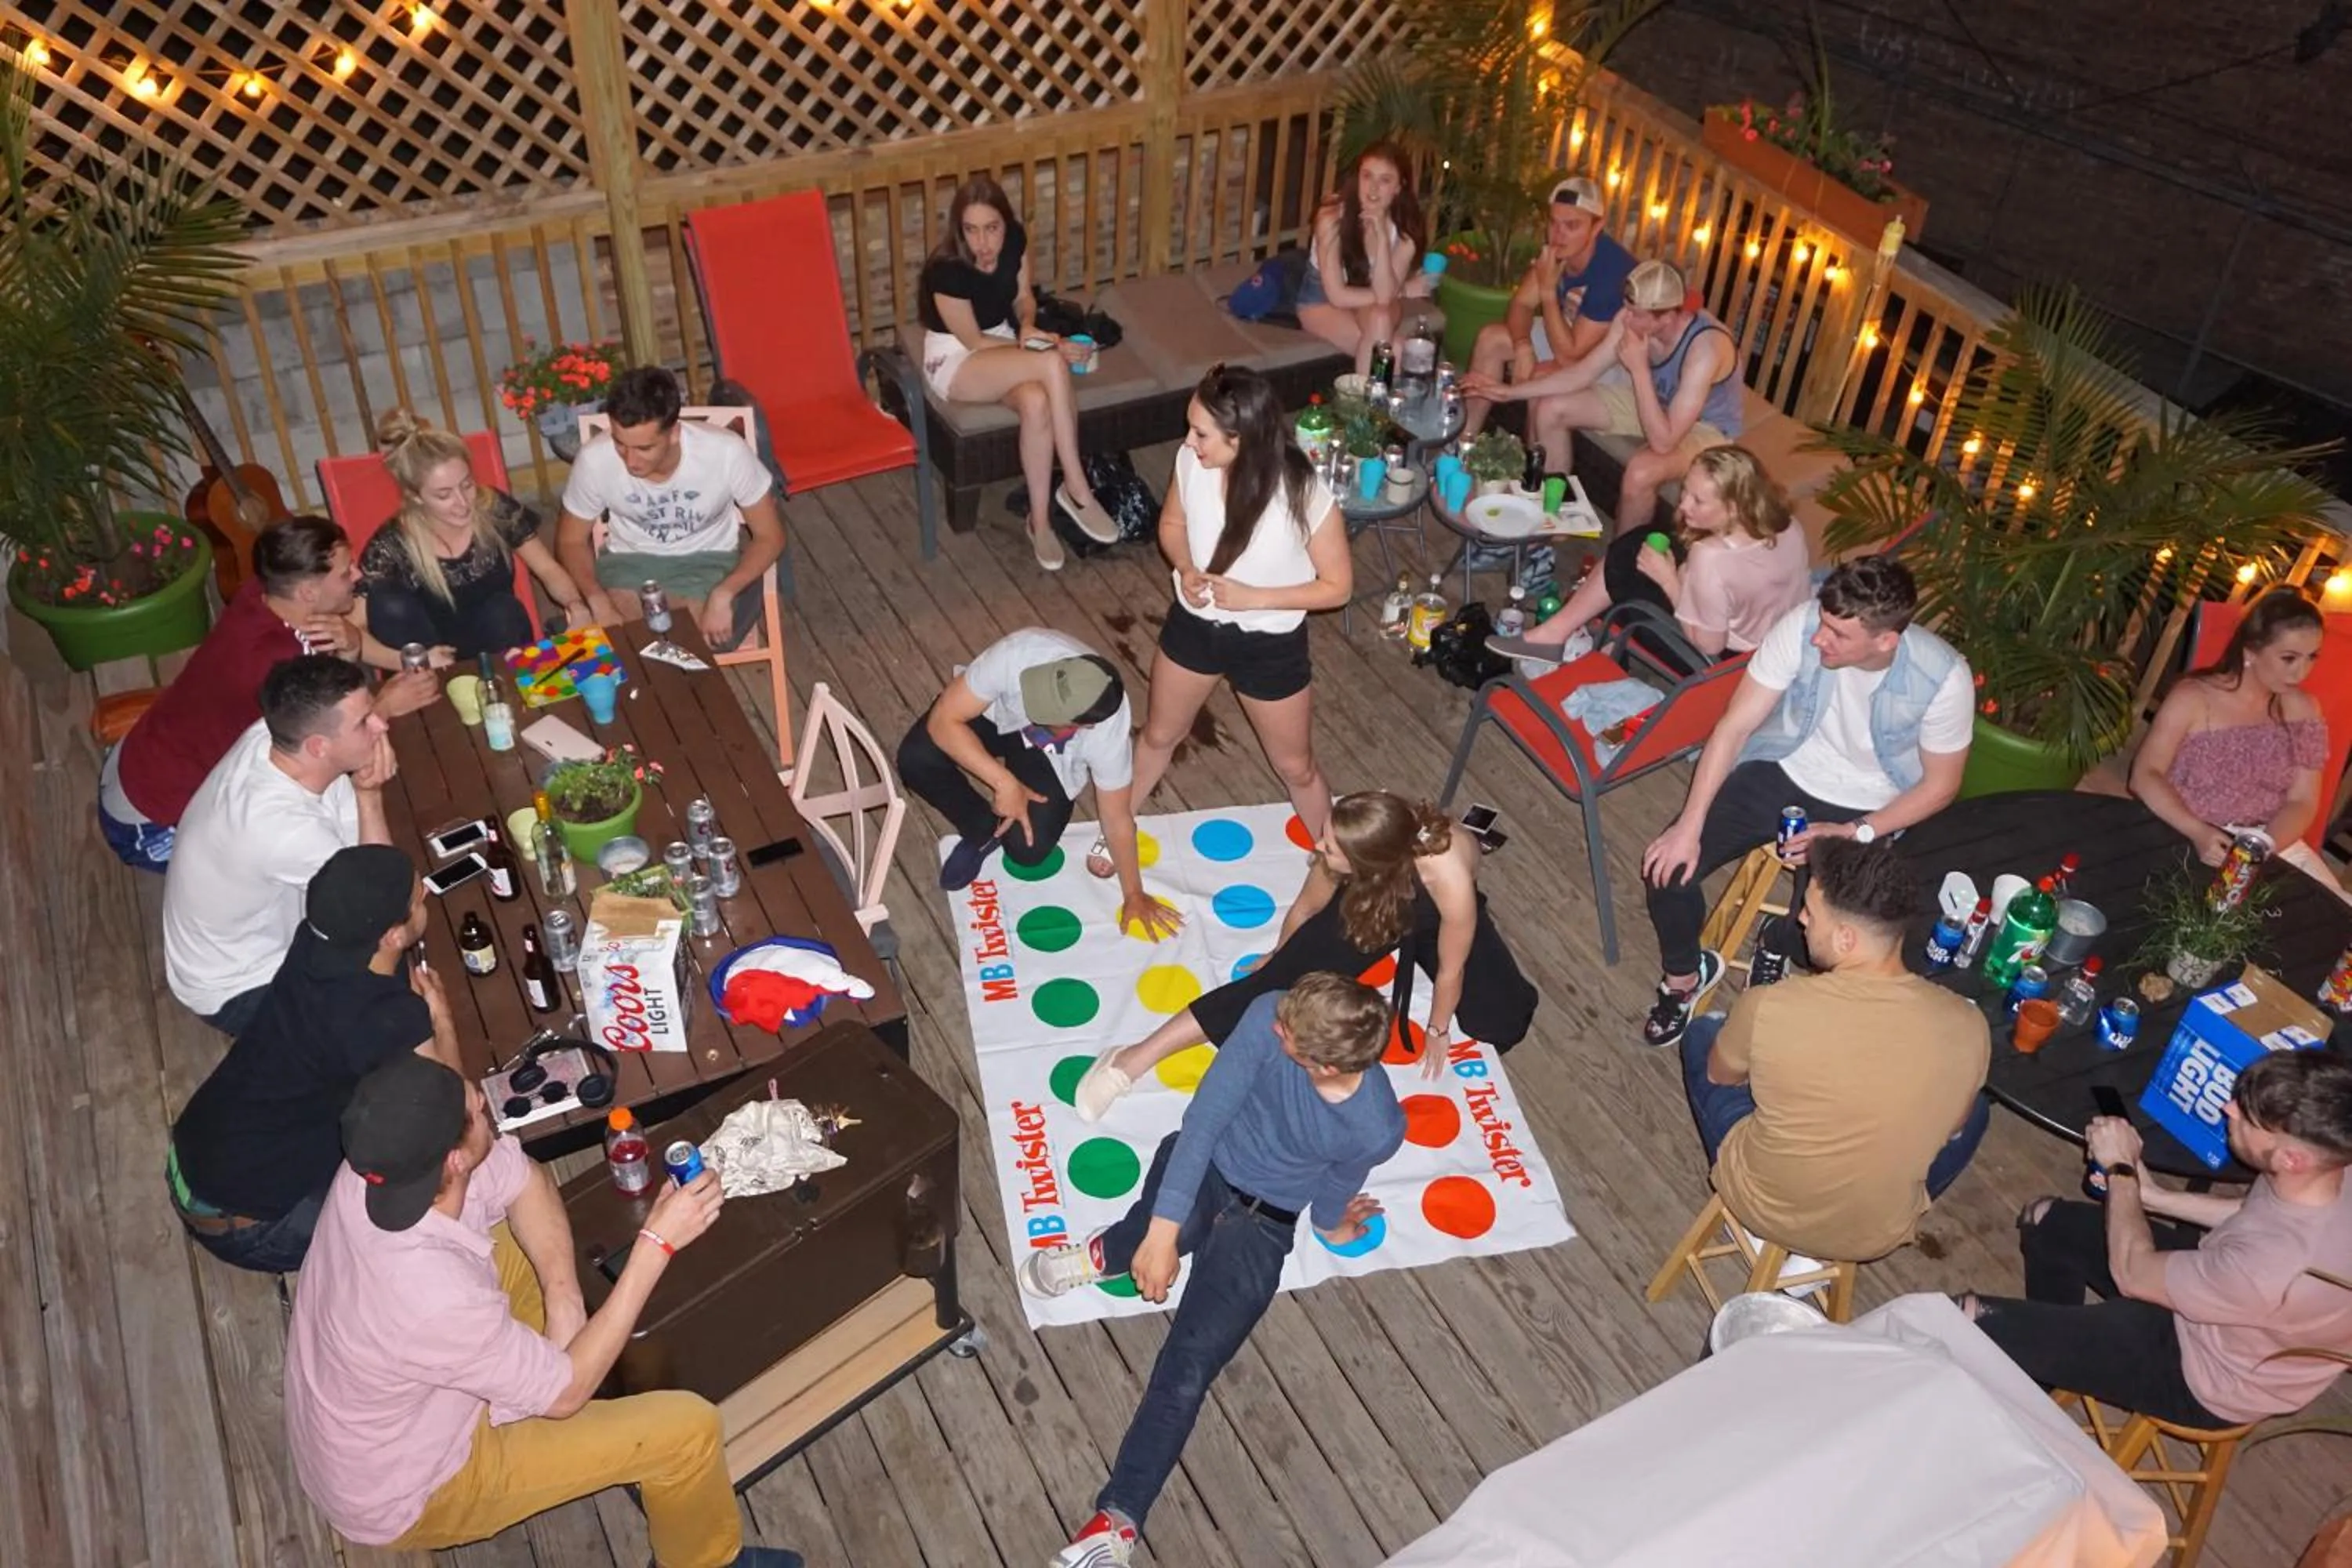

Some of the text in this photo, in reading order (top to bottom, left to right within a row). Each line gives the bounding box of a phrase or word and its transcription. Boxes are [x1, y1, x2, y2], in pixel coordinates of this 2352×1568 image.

[967, 879, 1008, 964] Twister
[602, 964, 653, 1053] Coors
[644, 989, 670, 1035] LIGHT
[2168, 1037, 2221, 1115] LIGHT
[2195, 1062, 2238, 1126] BUD
[1010, 1101, 1061, 1214] Twister
[1463, 1082, 1531, 1187] Twister
